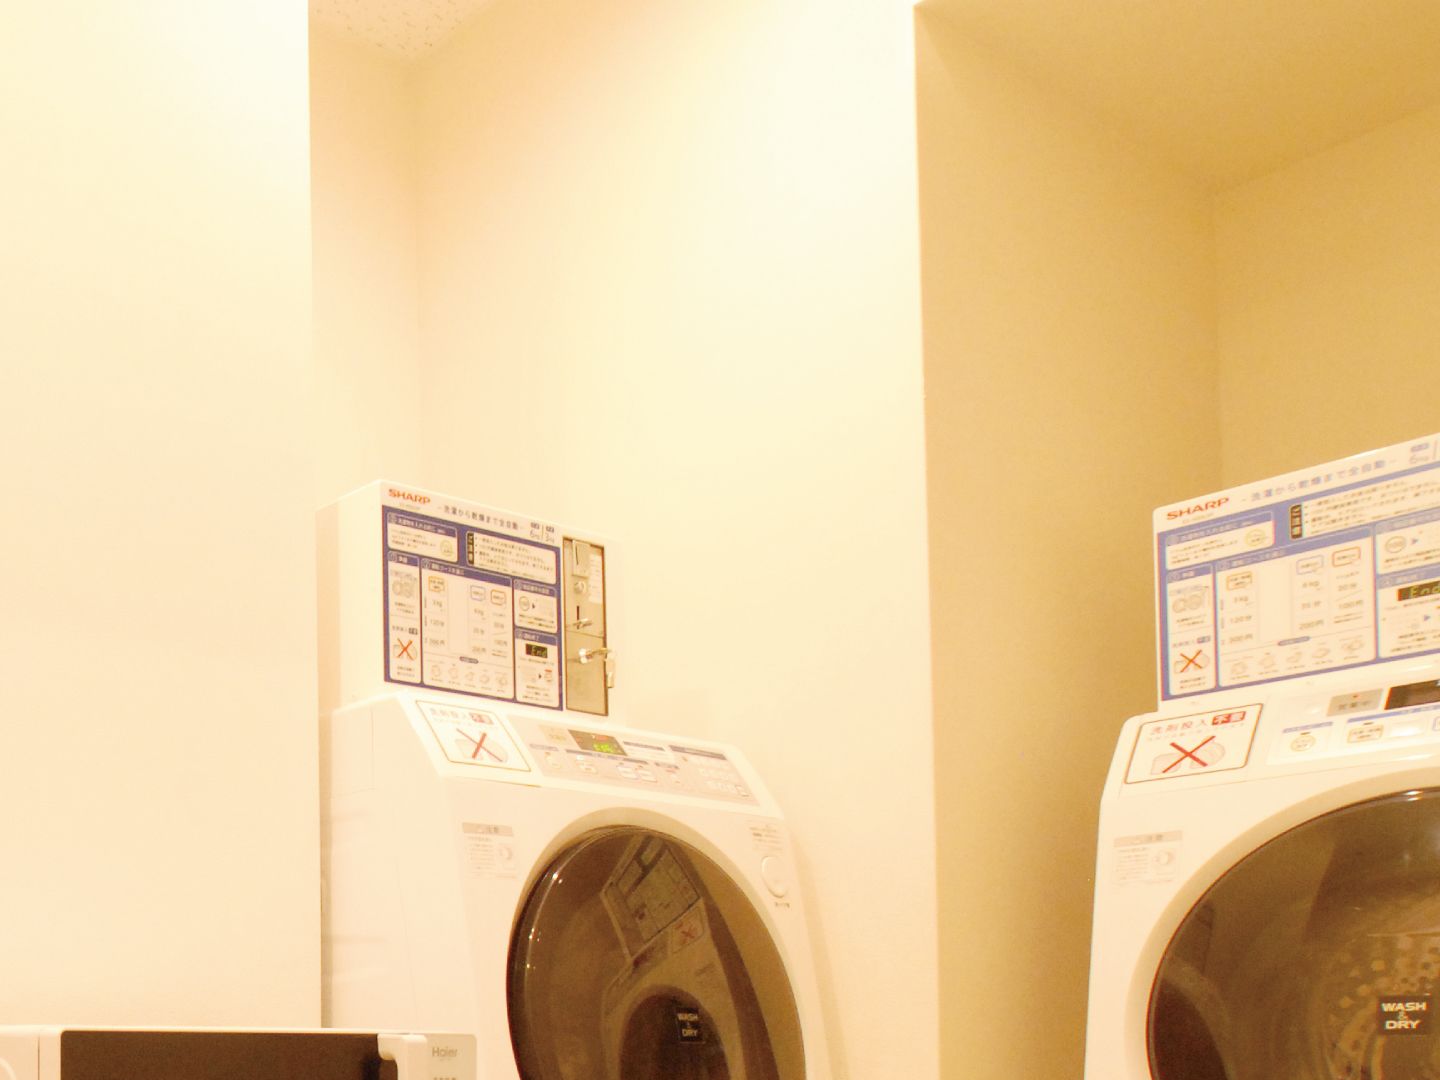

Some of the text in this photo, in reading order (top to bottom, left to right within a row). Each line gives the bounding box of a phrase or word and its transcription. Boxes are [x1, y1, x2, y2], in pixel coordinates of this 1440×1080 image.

[387, 487, 432, 505] SHARP
[1165, 496, 1231, 521] SHARP
[1380, 1001, 1428, 1013] WASH
[1384, 1020, 1421, 1031] DRY
